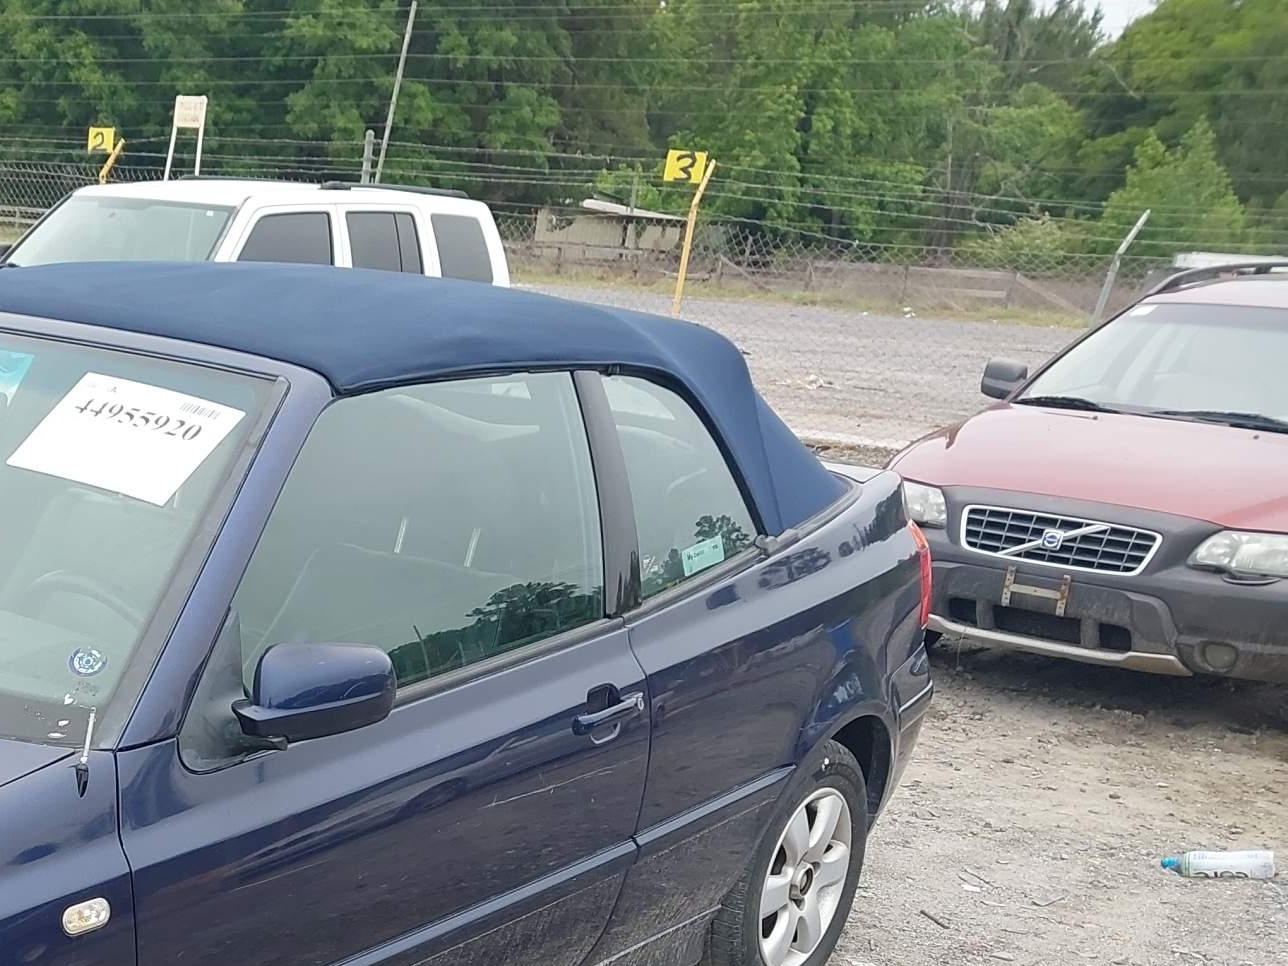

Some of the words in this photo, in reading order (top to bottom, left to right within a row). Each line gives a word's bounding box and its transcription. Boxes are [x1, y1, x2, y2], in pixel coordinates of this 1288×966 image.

[91, 131, 107, 152] 2
[673, 151, 697, 181] 3
[75, 397, 203, 441] 44955920
